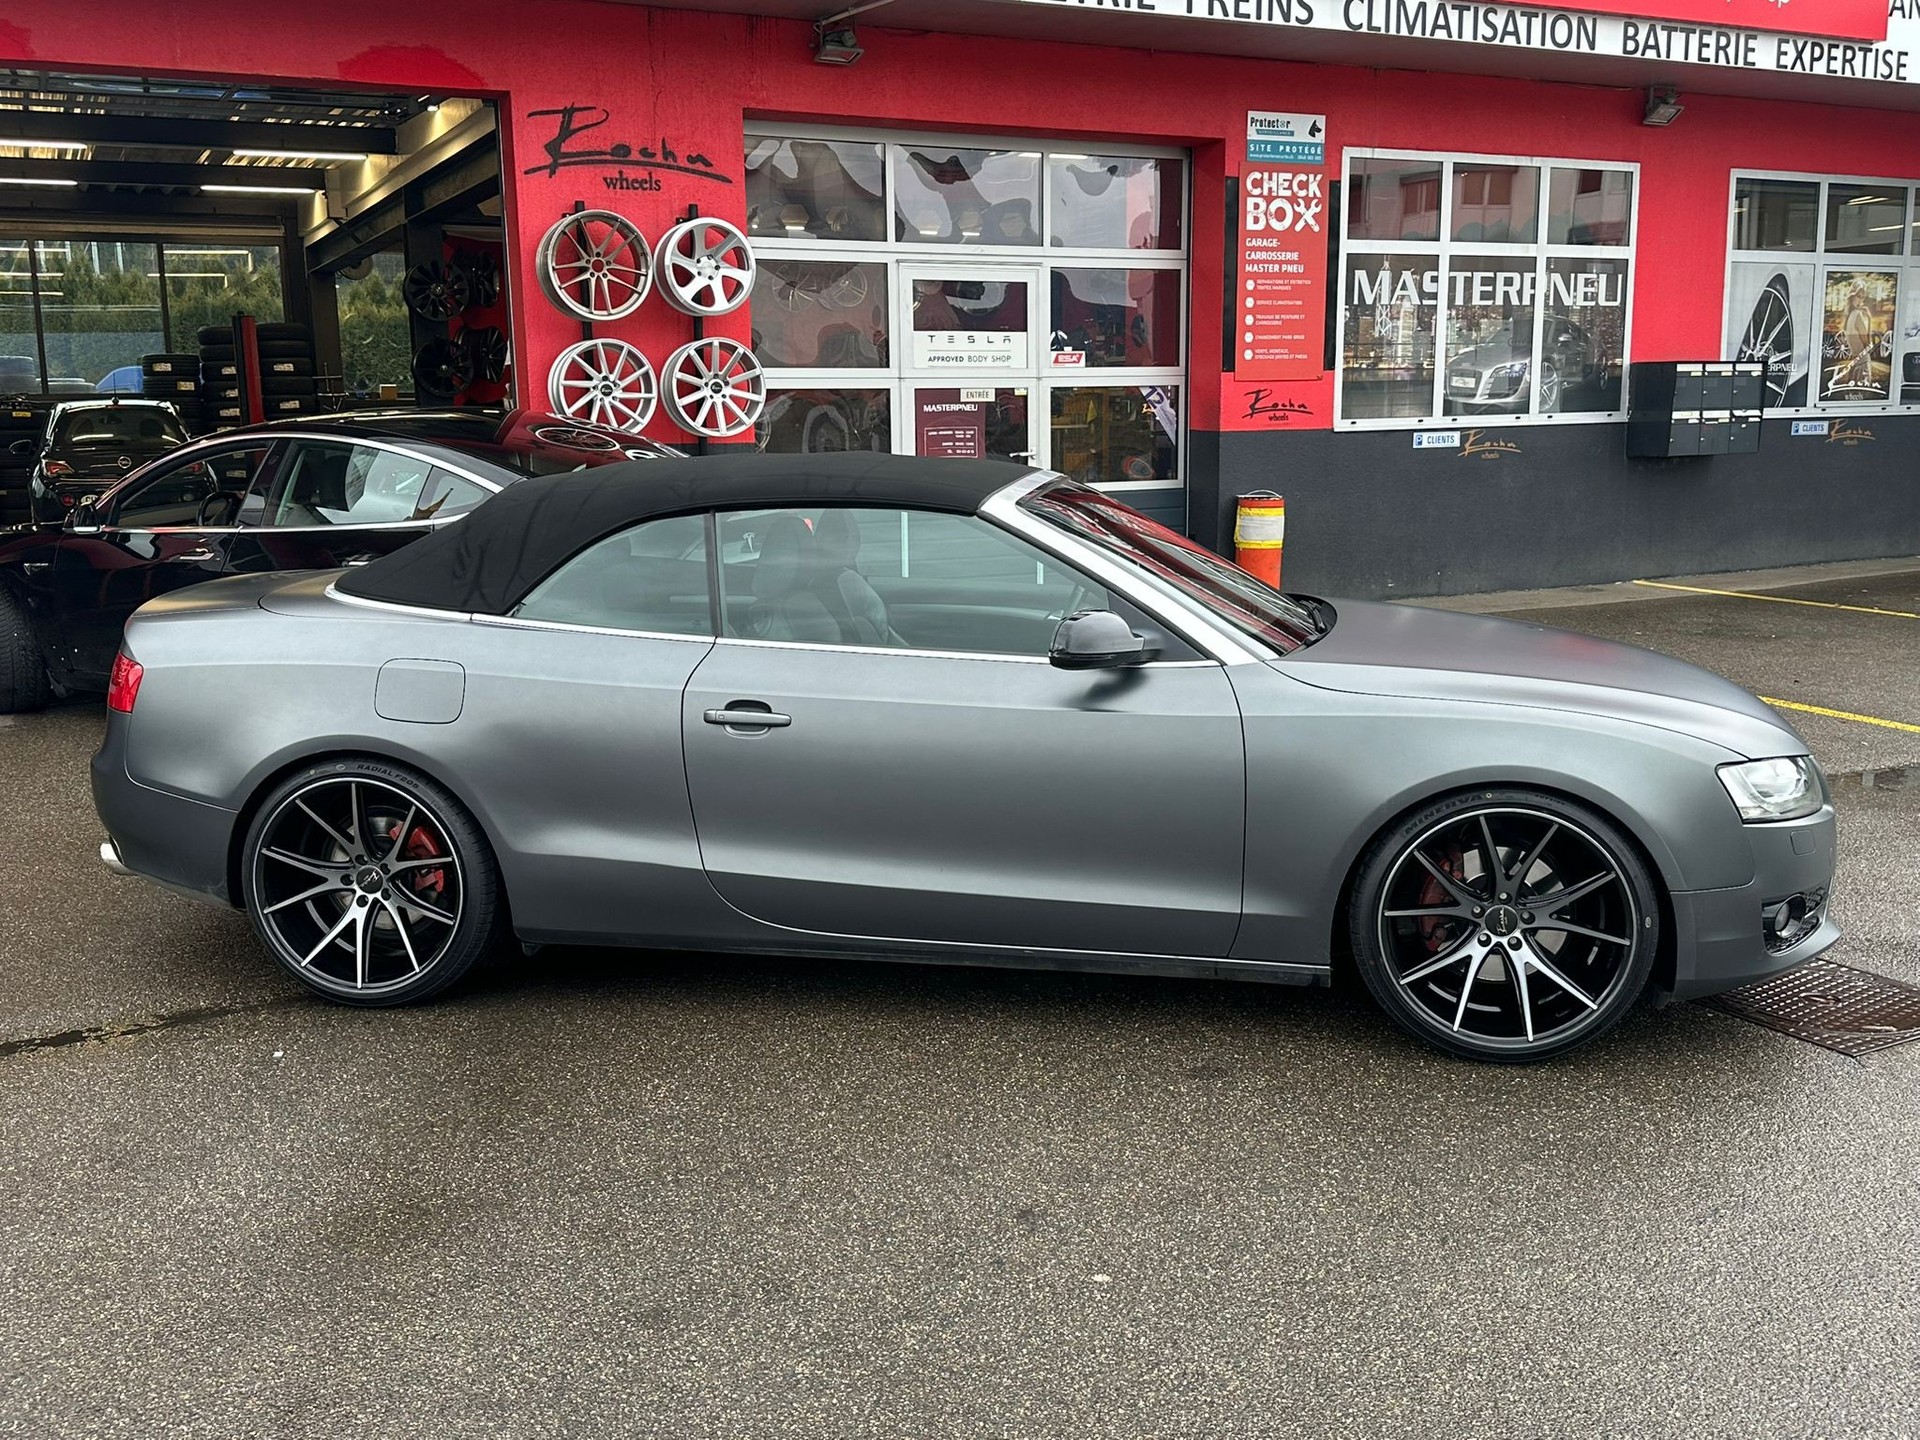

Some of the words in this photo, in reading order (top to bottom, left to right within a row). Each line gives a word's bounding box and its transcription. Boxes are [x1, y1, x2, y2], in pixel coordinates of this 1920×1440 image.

[1343, 0, 1597, 51] CLIMATISATION
[1622, 21, 1758, 67] BATTERIE
[1776, 37, 1908, 81] EXPERTISE
[1249, 143, 1272, 152] SITE
[602, 170, 662, 191] wheels
[1246, 171, 1323, 198] CHECK
[1246, 197, 1322, 232] BOX
[1245, 238, 1280, 247] GARAGE-
[1245, 251, 1299, 261] CARROSSERIE
[1245, 264, 1280, 273] MASTER
[1281, 264, 1304, 273] PNEU
[1352, 269, 1623, 307] MASTERPNEU
[928, 334, 1011, 344] TESLA
[928, 355, 965, 363] APPROVED
[967, 355, 989, 363] BODY
[991, 355, 1011, 363] SHOP
[966, 390, 990, 399] ENTRÉE
[923, 403, 978, 413] MASTERPNEU
[1427, 435, 1455, 445] CLIENTS
[356, 764, 393, 777] RADIAL
